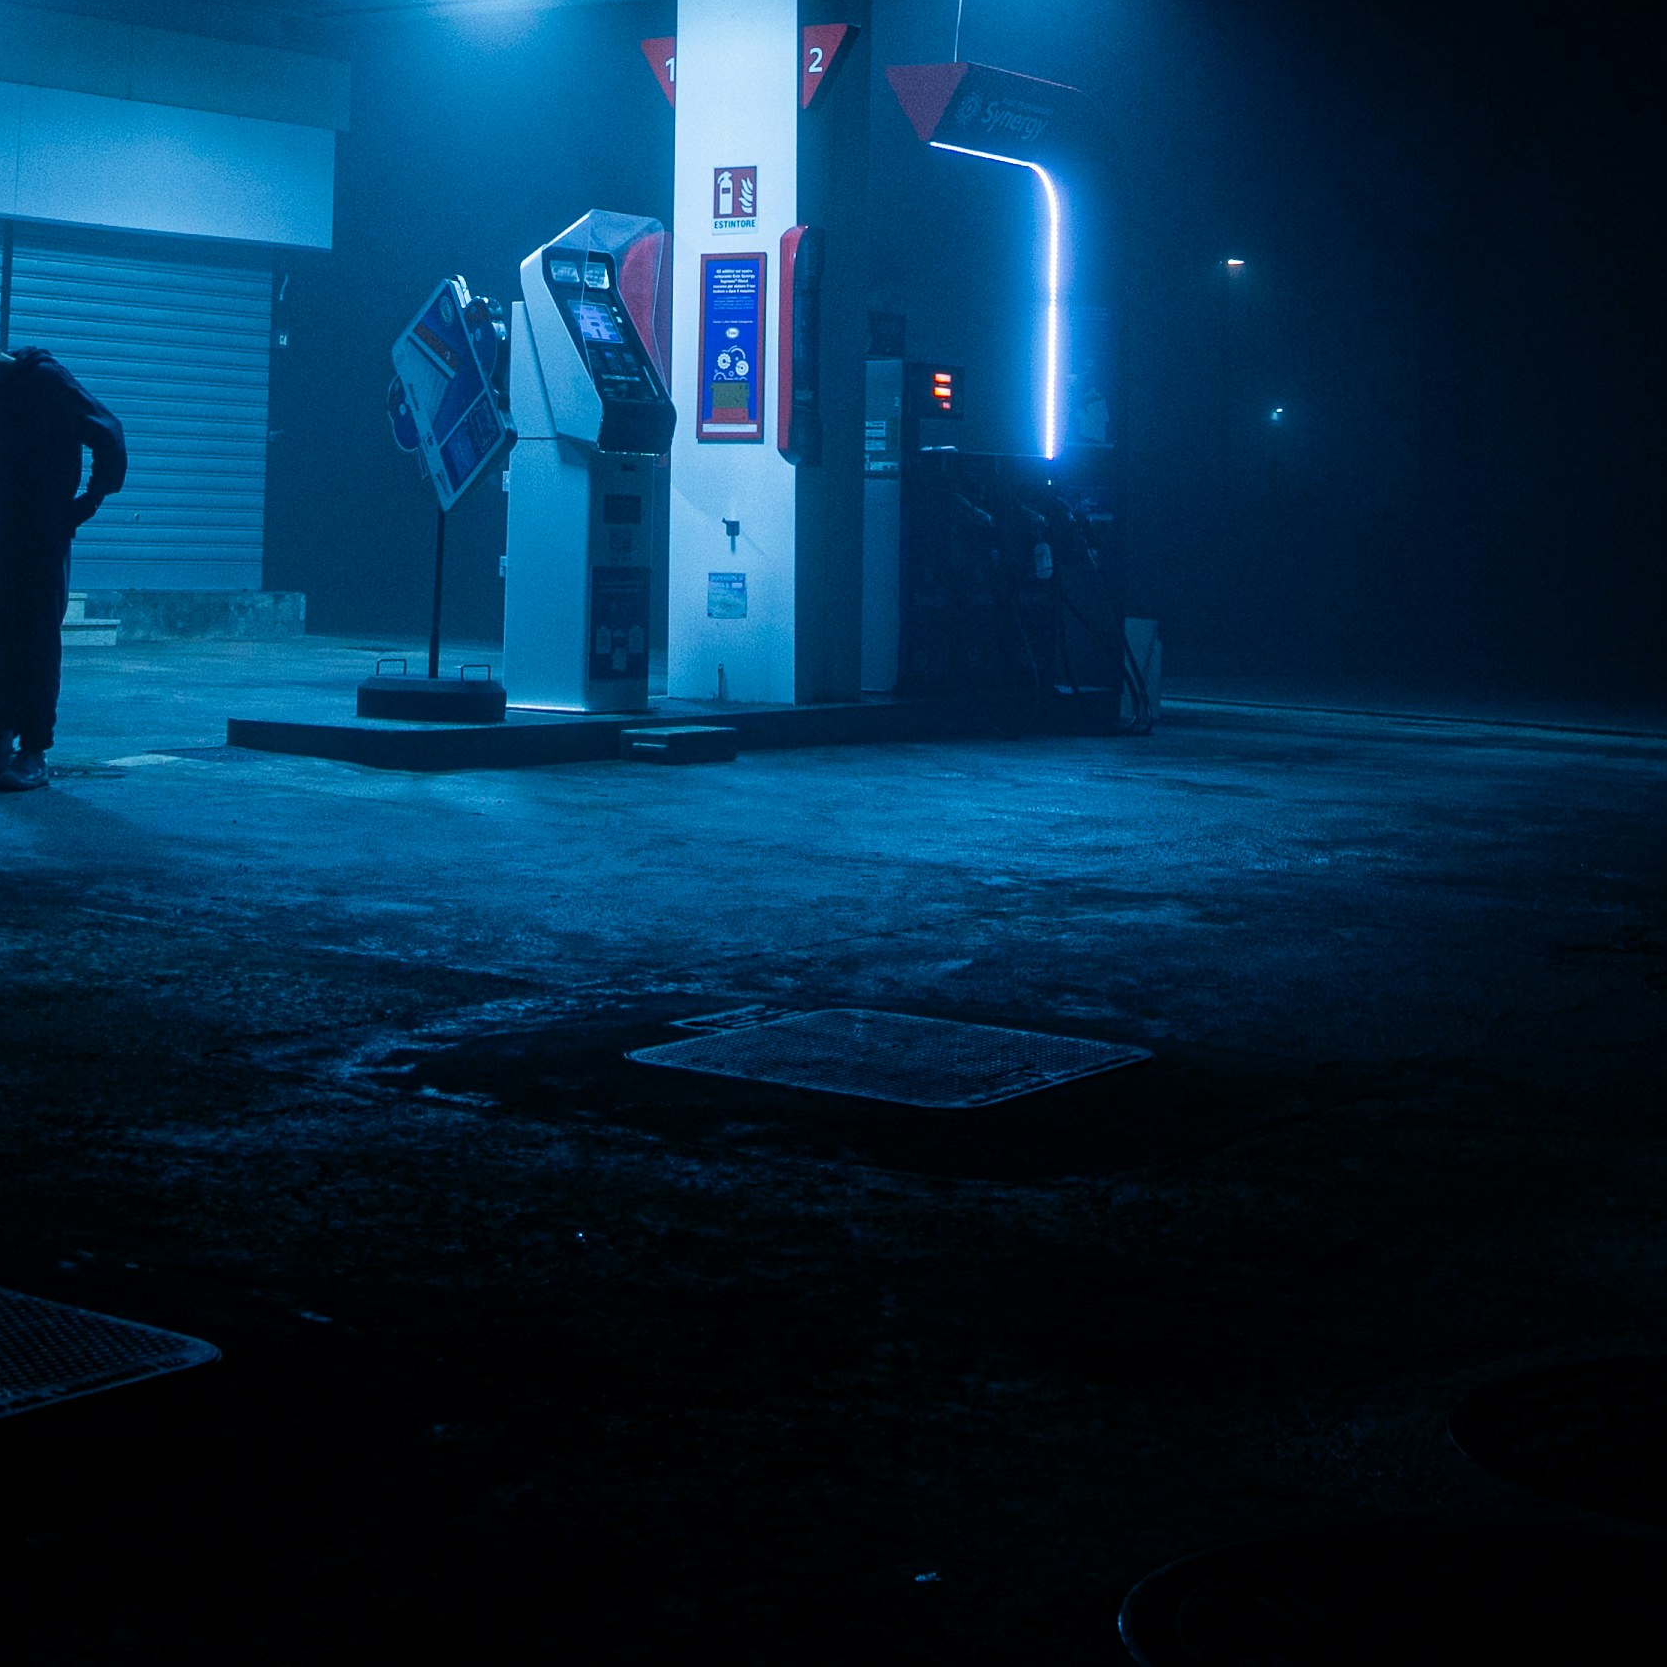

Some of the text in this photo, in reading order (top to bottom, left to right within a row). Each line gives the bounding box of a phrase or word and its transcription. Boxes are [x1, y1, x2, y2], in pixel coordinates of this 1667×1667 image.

[665, 57, 675, 82] 1
[808, 47, 823, 73] 2
[980, 100, 1048, 141] Synergy
[714, 219, 756, 229] ESTINTORE
